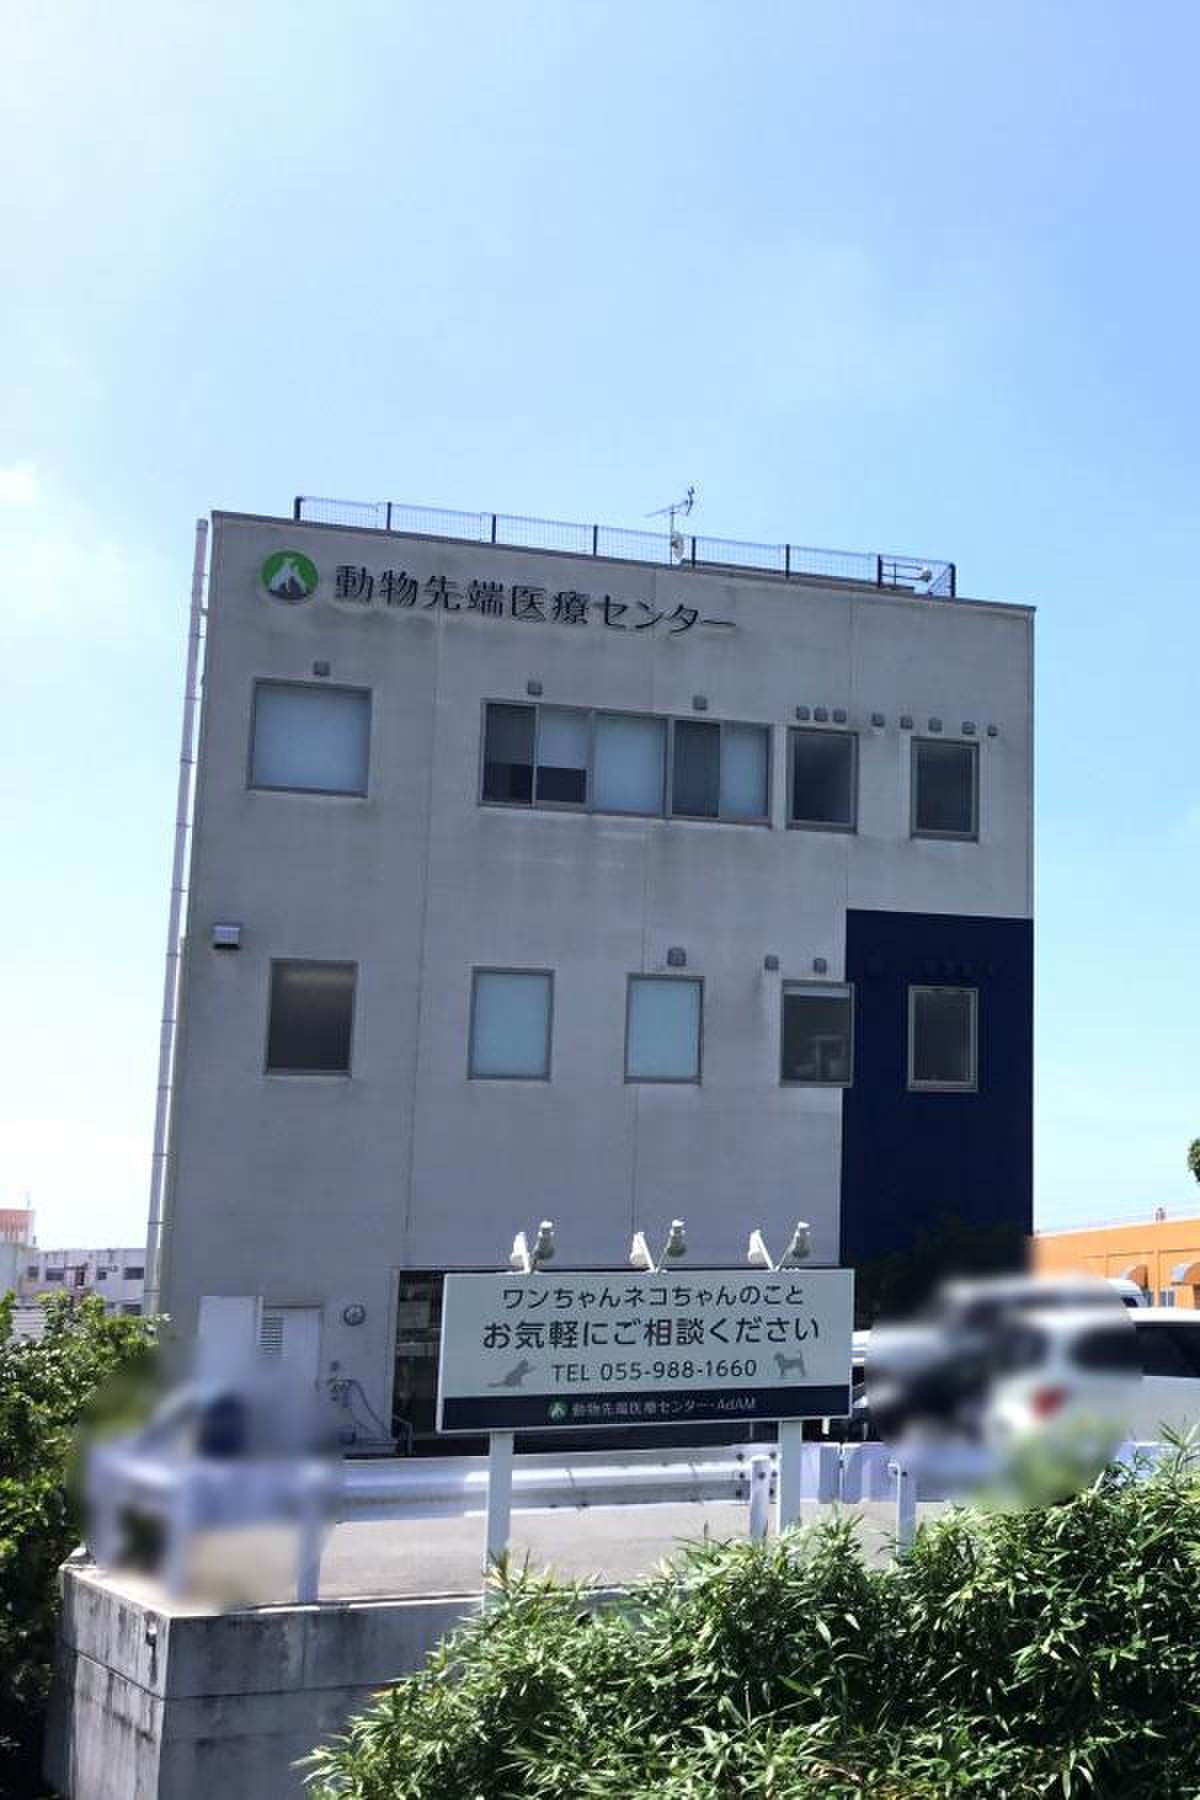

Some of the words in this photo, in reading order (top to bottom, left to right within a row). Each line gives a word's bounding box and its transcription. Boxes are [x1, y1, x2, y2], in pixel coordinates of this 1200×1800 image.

[334, 564, 737, 635] 動物先端医療センター
[503, 1285, 805, 1310] ワンちゃんネコちゃんのこと
[482, 1317, 820, 1350] お気軽にご相談ください
[552, 1363, 590, 1381] TEL
[600, 1359, 757, 1381] 055-988-1660
